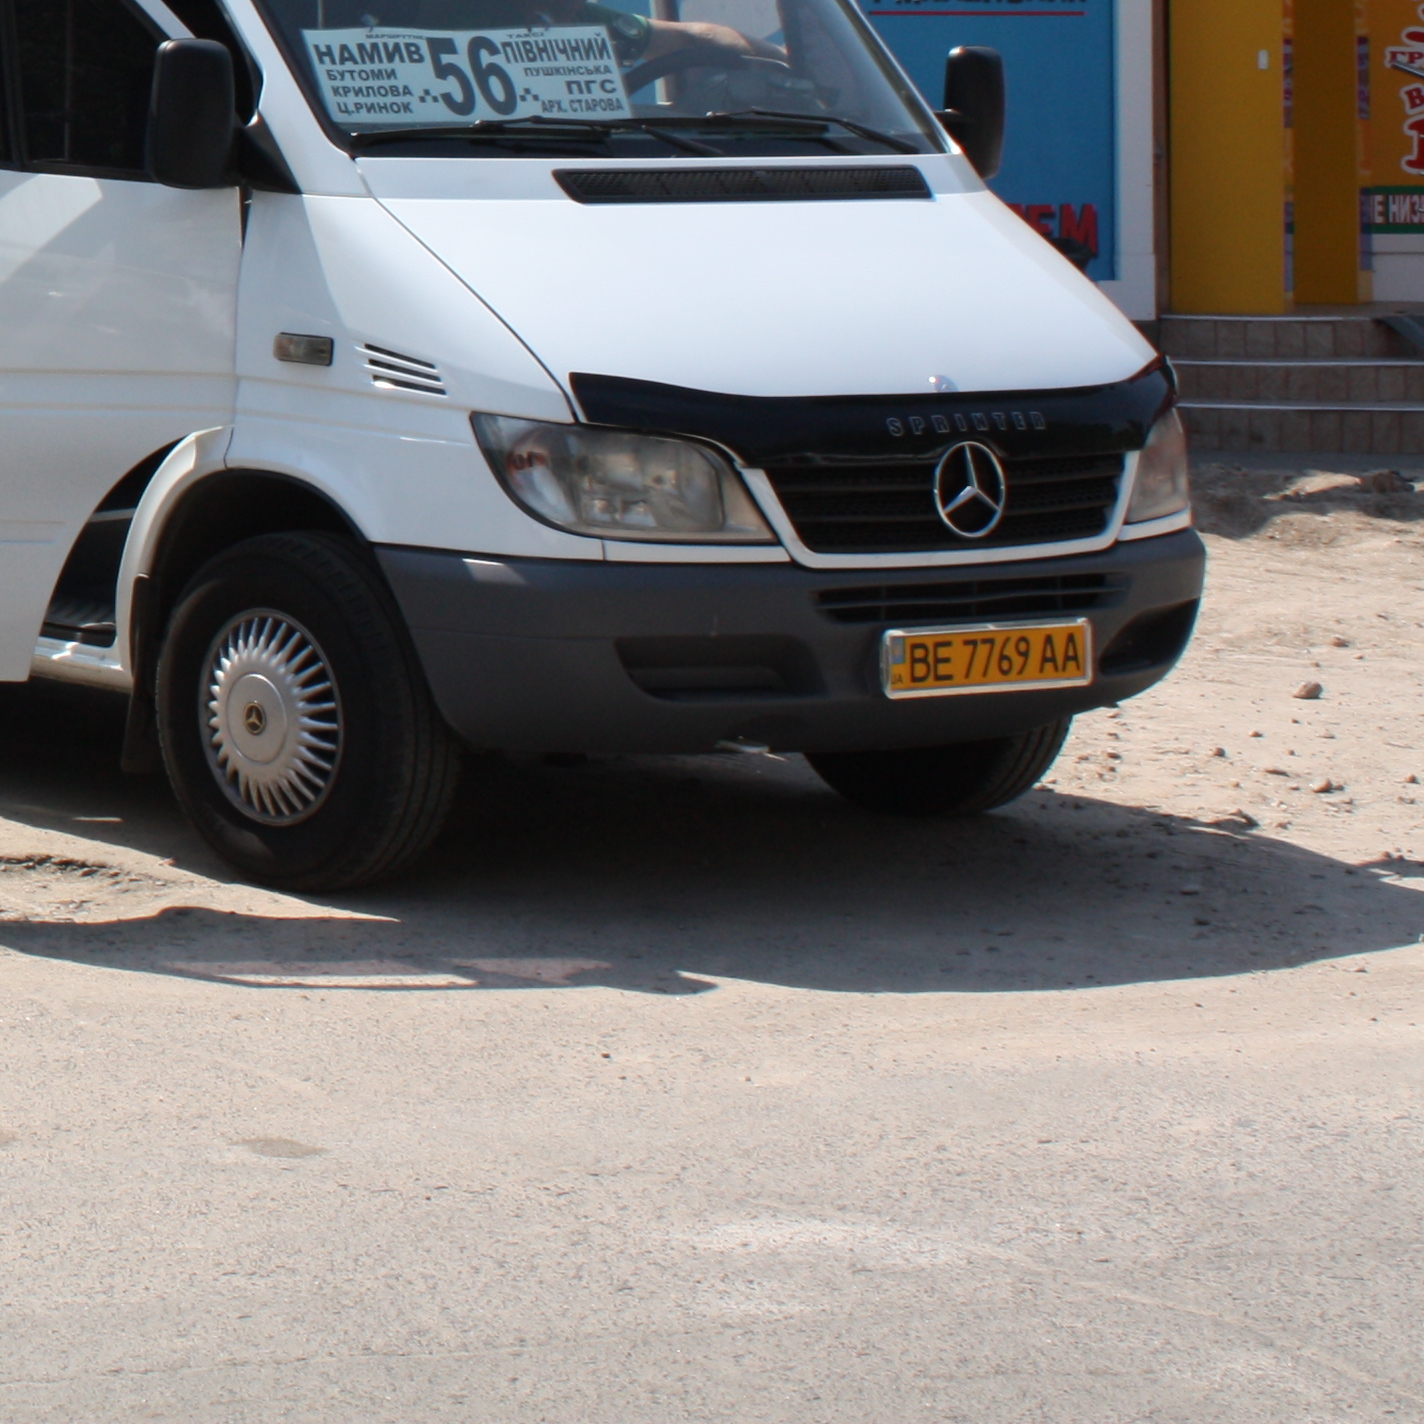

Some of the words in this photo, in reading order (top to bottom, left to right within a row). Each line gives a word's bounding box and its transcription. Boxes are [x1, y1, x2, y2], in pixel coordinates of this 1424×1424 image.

[313, 41, 426, 66] НАМИВ
[500, 32, 612, 64] ПІВНІЧНИЙ
[325, 68, 398, 82] БУТОМИ
[426, 36, 518, 116] 56
[522, 64, 613, 77] ПУШКІНСЬКА
[331, 85, 414, 98] КРИЛОВА
[565, 79, 617, 95] ПГС
[336, 101, 414, 116] Ц.РИНОК
[569, 98, 624, 112] СТАРОВА
[885, 410, 1048, 437] SPRINTER
[909, 640, 955, 684] BE
[962, 636, 1032, 680] 7769
[1038, 632, 1082, 675] AA
